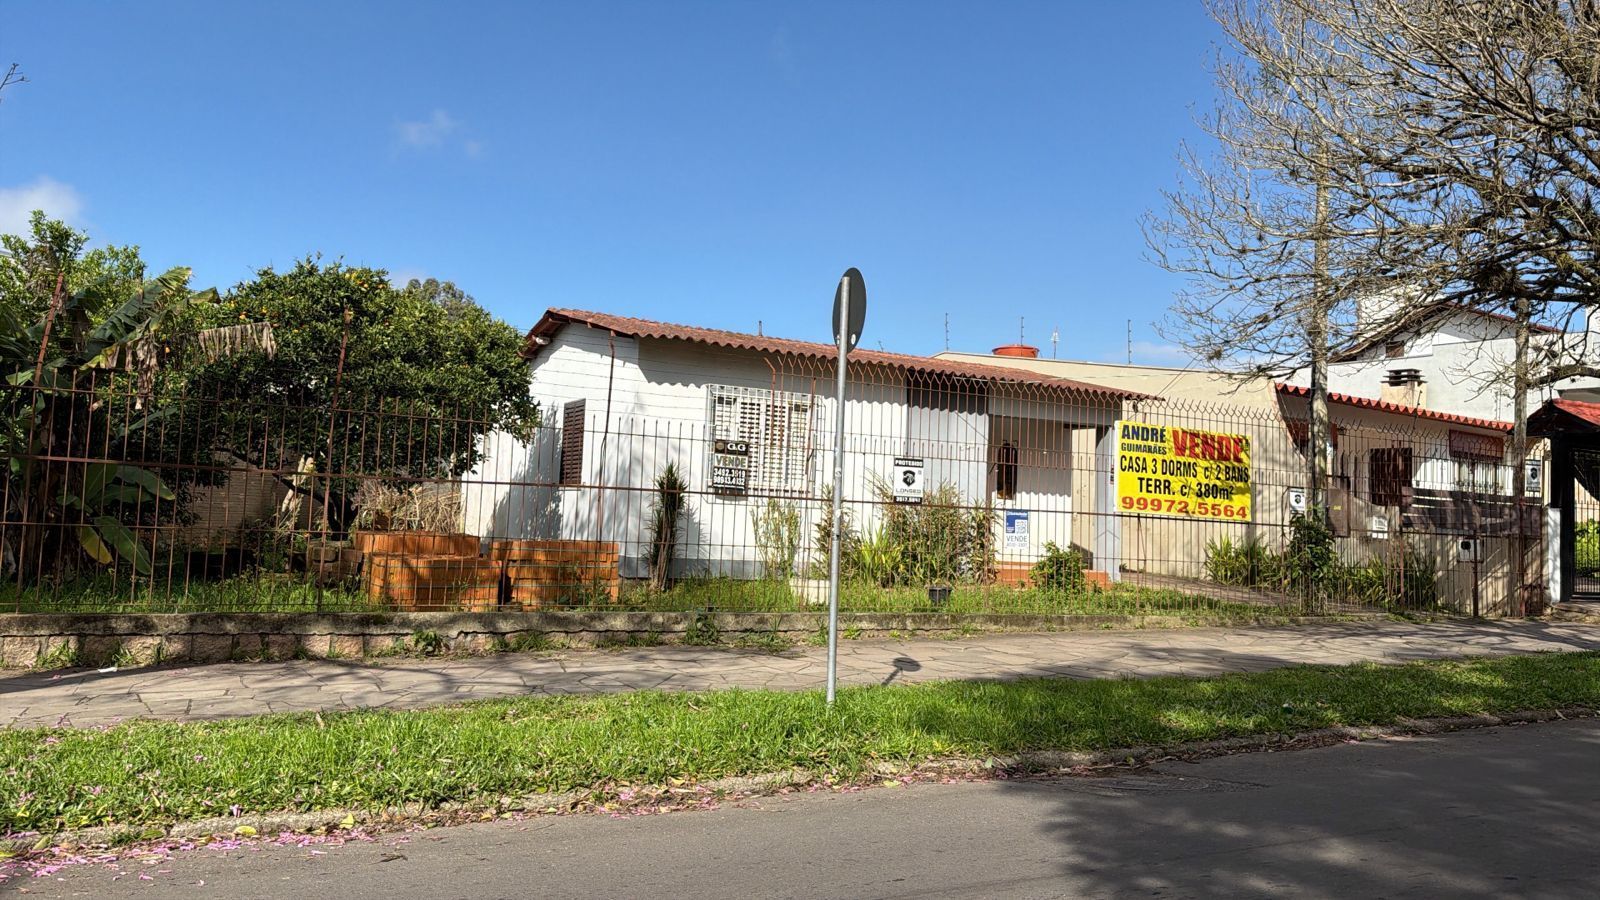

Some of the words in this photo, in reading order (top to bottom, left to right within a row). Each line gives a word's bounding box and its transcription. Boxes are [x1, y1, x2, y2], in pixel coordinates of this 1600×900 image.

[1121, 425, 1167, 443] ANDRÉ
[1121, 443, 1167, 455] GUIMARÃES
[1171, 429, 1244, 463] VENDE
[715, 455, 747, 468] VENDE
[1120, 455, 1148, 474] CASA
[1151, 458, 1158, 475] 3
[1161, 459, 1198, 479] DORMS
[1215, 465, 1222, 481] 2
[1224, 466, 1249, 483] BANS
[1137, 477, 1176, 495] TERR.
[1180, 481, 1192, 498] c/
[1121, 496, 1248, 519] 99972.5564
